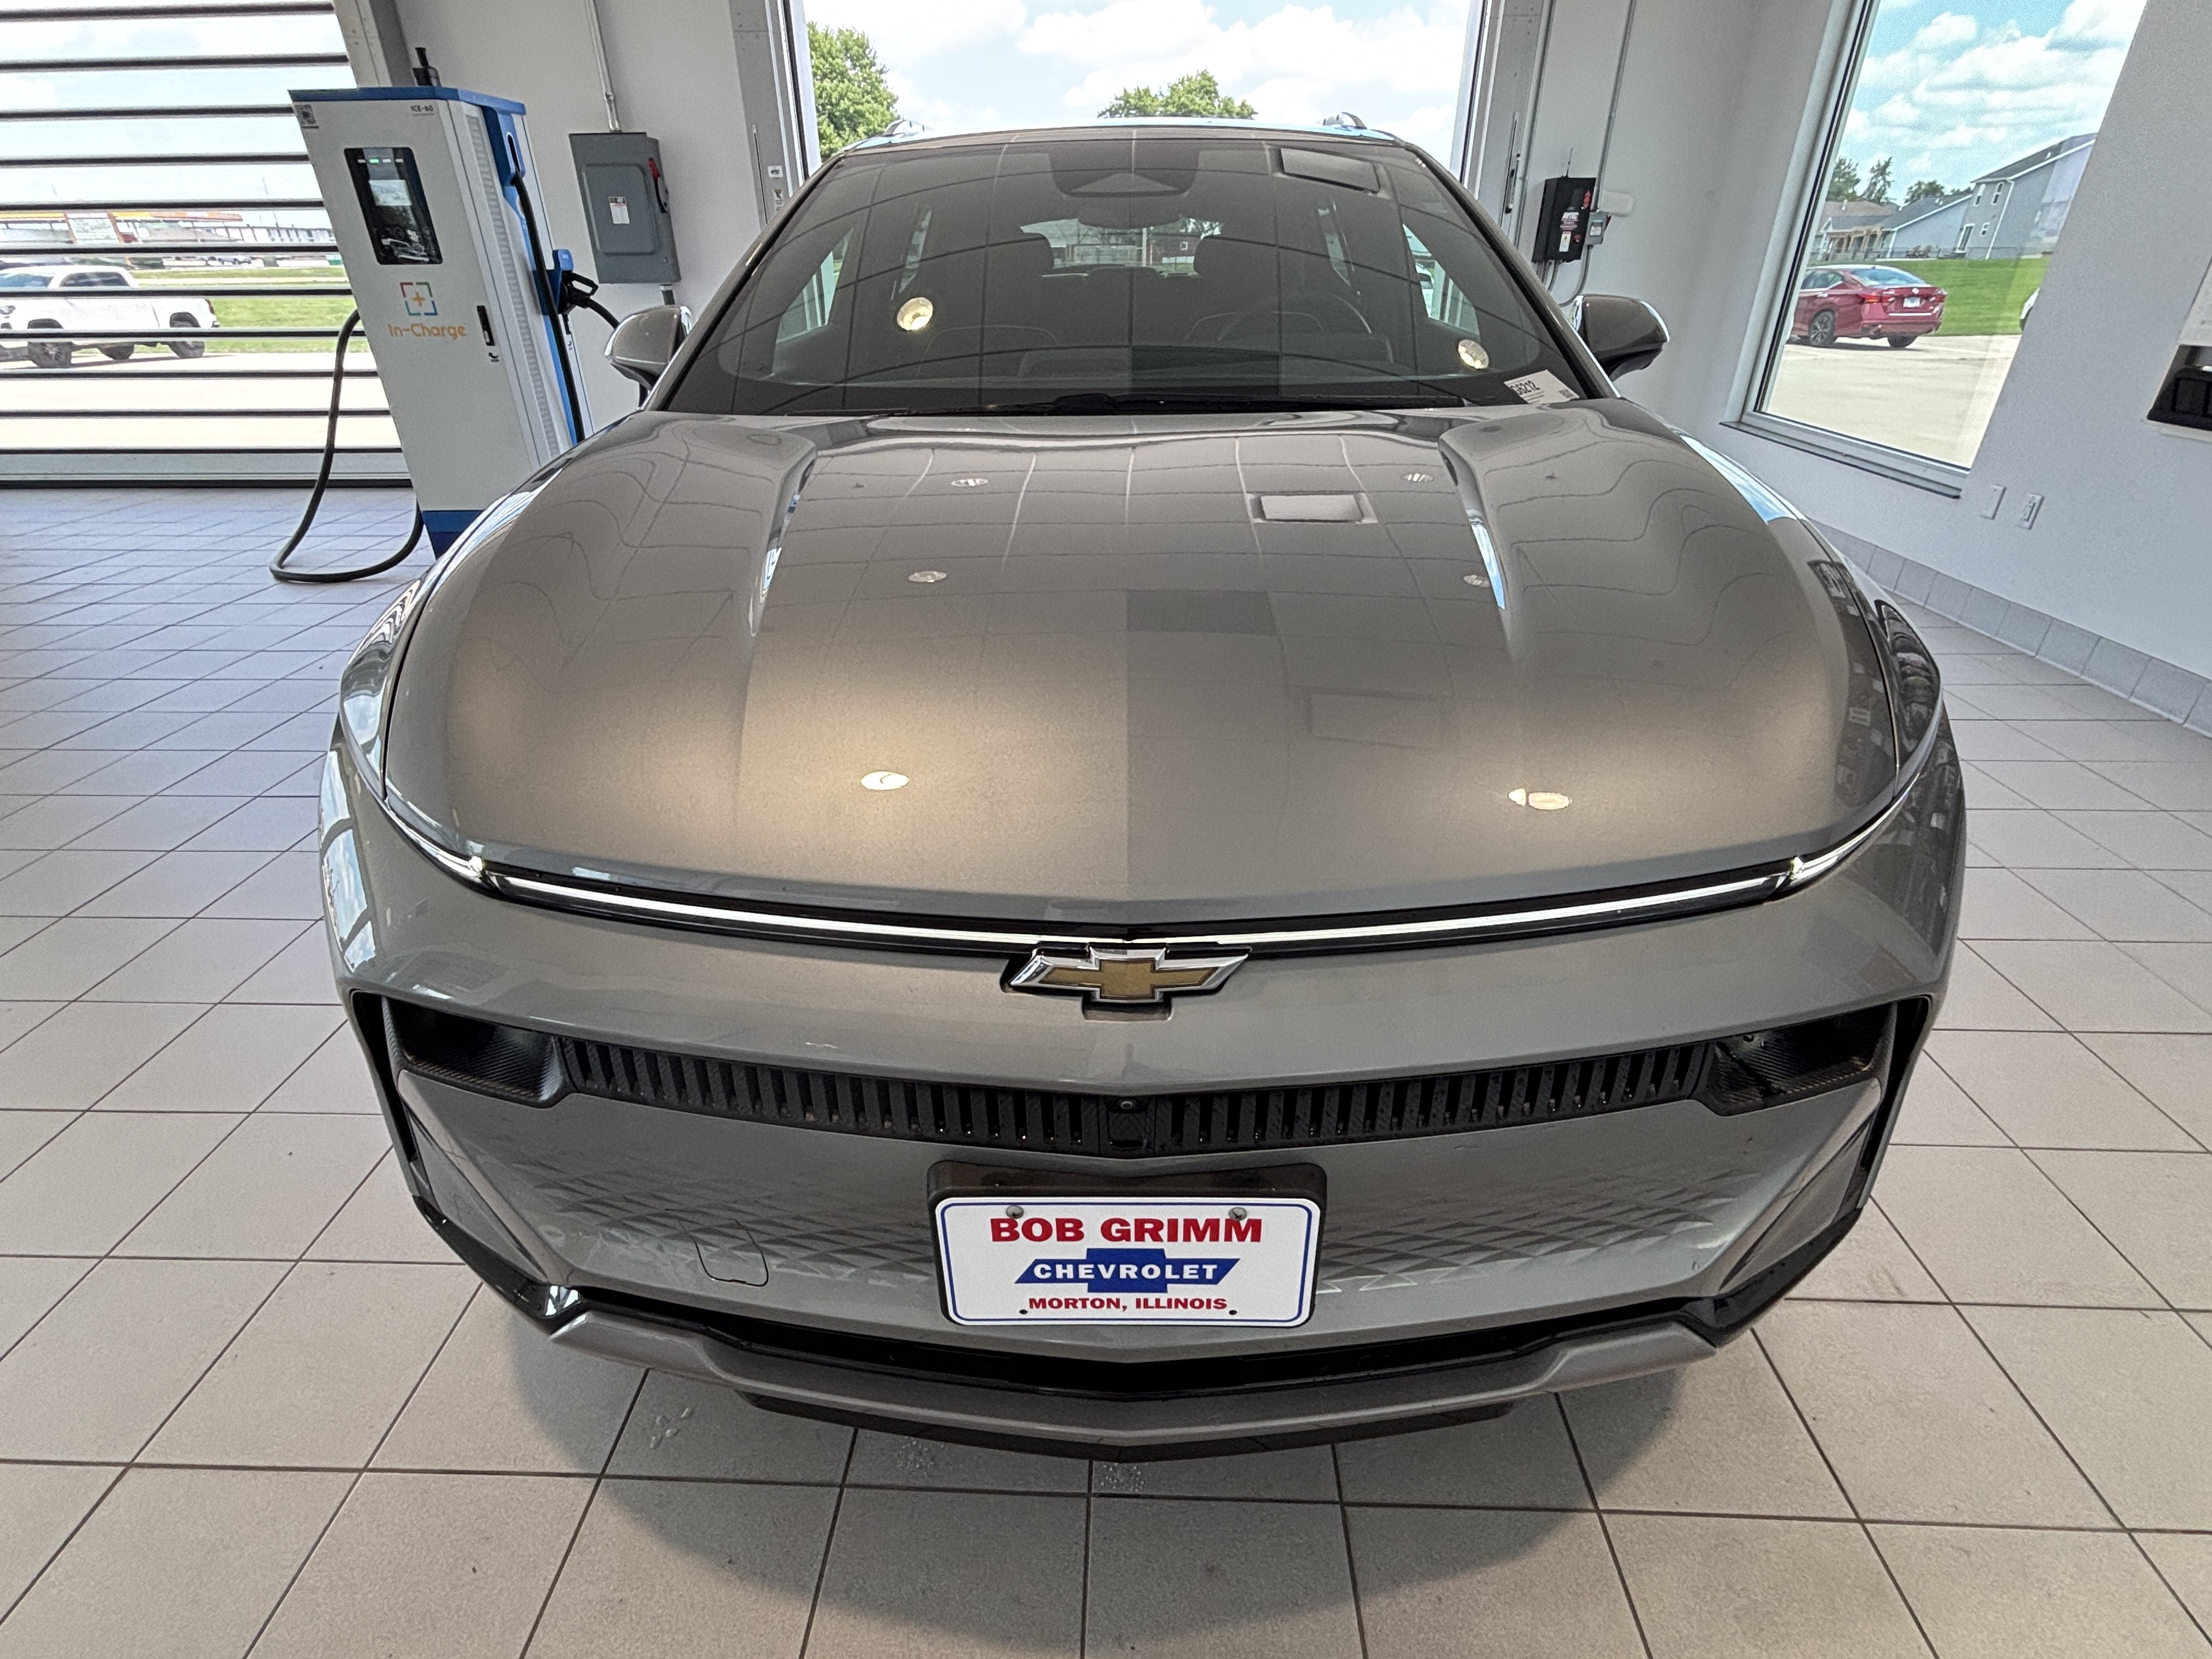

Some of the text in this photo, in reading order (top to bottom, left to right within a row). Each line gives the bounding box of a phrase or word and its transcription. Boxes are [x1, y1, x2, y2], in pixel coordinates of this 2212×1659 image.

[387, 323, 466, 341] In-Charge
[990, 1217, 1262, 1242] BOB GRIMM
[1034, 1264, 1217, 1279] CHEVROLET
[1029, 1297, 1227, 1312] MORTON, ILLINOIS
